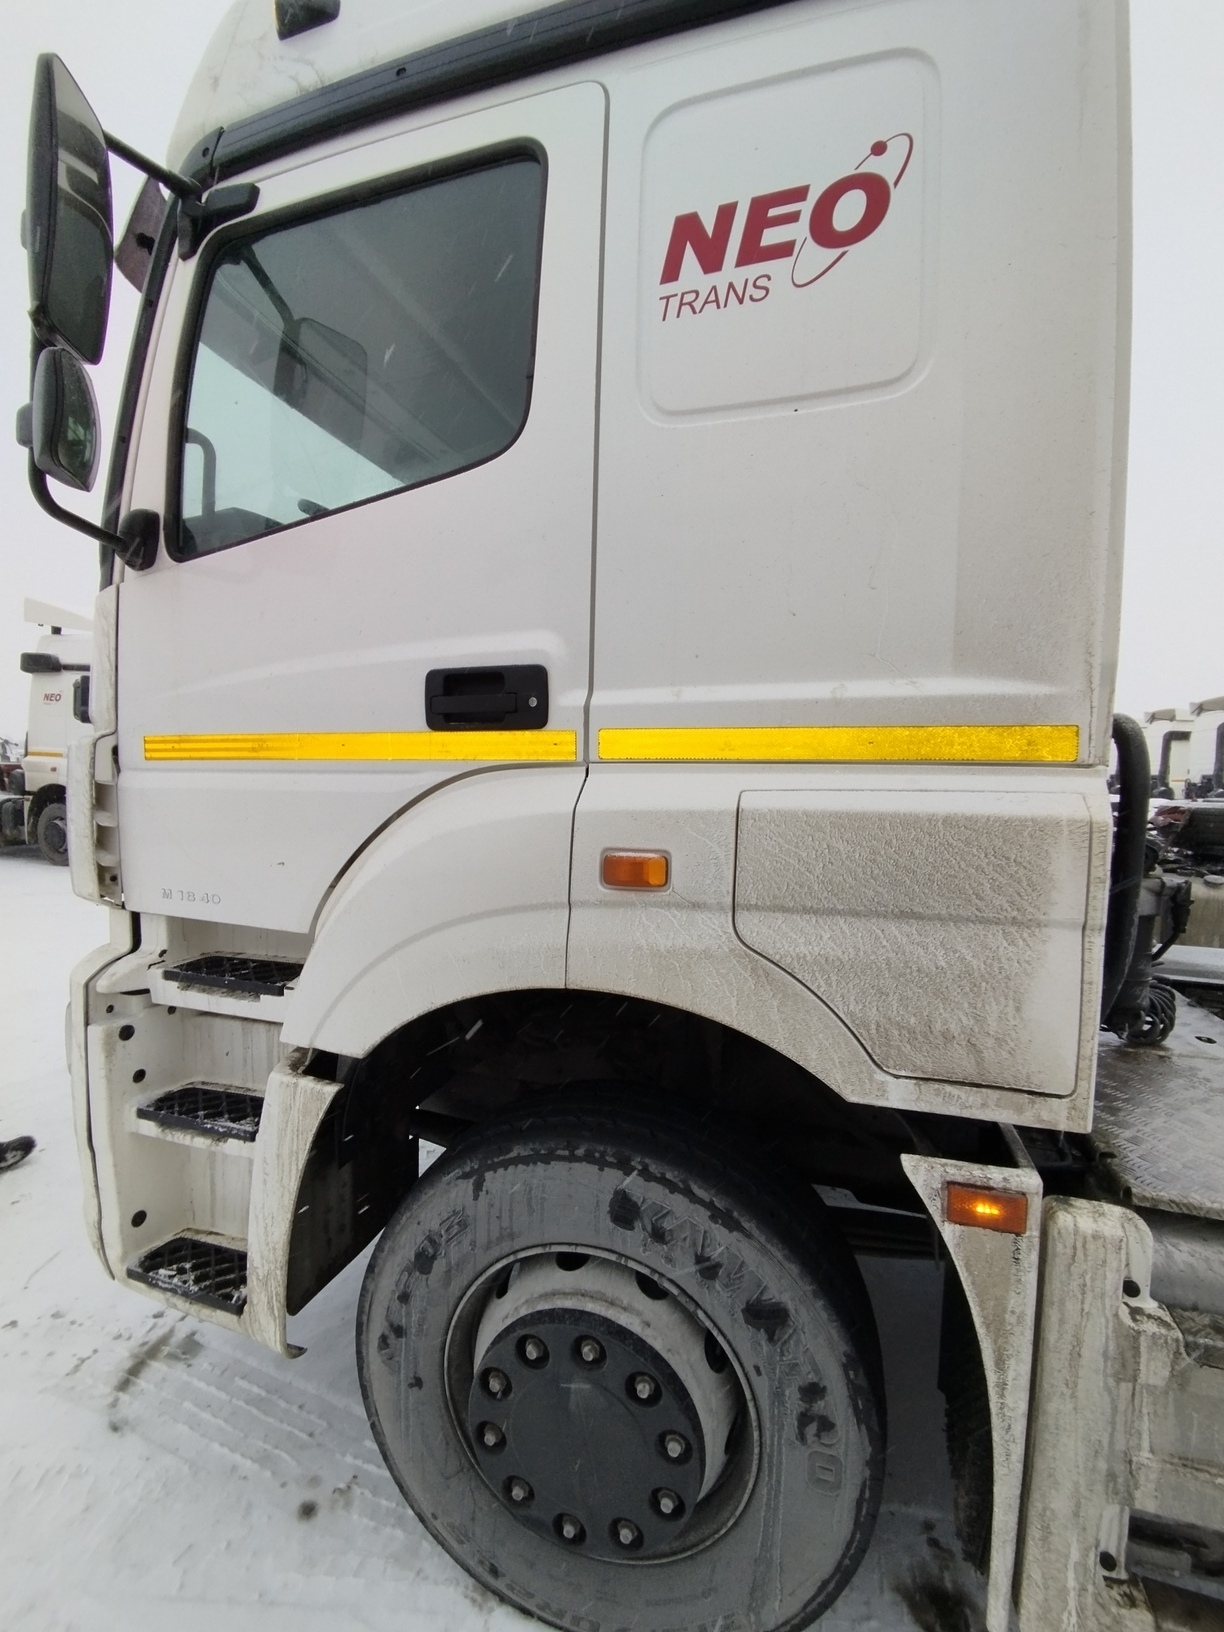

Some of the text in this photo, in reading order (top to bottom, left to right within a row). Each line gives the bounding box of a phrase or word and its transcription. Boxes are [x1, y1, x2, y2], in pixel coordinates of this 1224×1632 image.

[659, 171, 891, 286] NEO
[659, 273, 772, 322] TRANS
[43, 693, 62, 703] NEO
